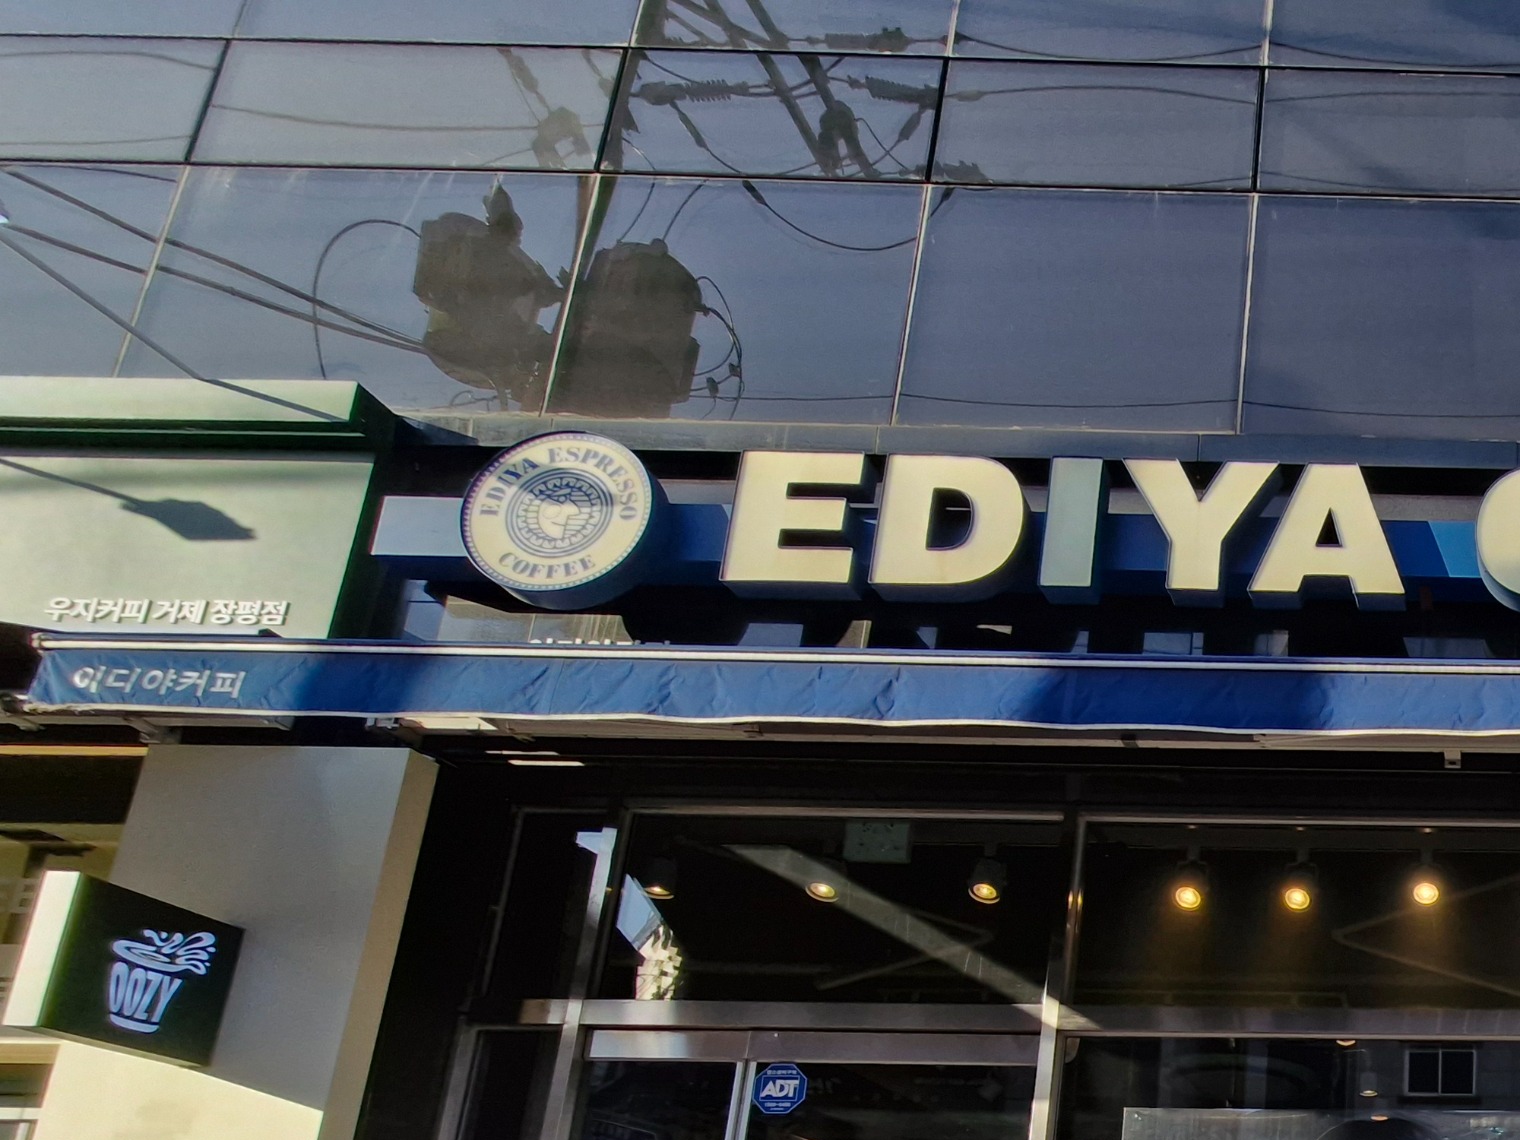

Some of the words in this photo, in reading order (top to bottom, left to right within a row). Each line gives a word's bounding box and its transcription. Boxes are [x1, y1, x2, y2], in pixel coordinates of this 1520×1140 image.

[480, 457, 540, 516] EDIYA
[548, 447, 638, 521] ESPRESSO
[719, 450, 1406, 597] EDIYA
[498, 552, 597, 580] COFFEE
[44, 596, 150, 624] 우지커피
[152, 600, 208, 625] 거제
[210, 600, 290, 626] 장평점
[72, 666, 247, 698] 이디야커피
[108, 961, 183, 1024] OOZY
[760, 1079, 800, 1098] ADT
